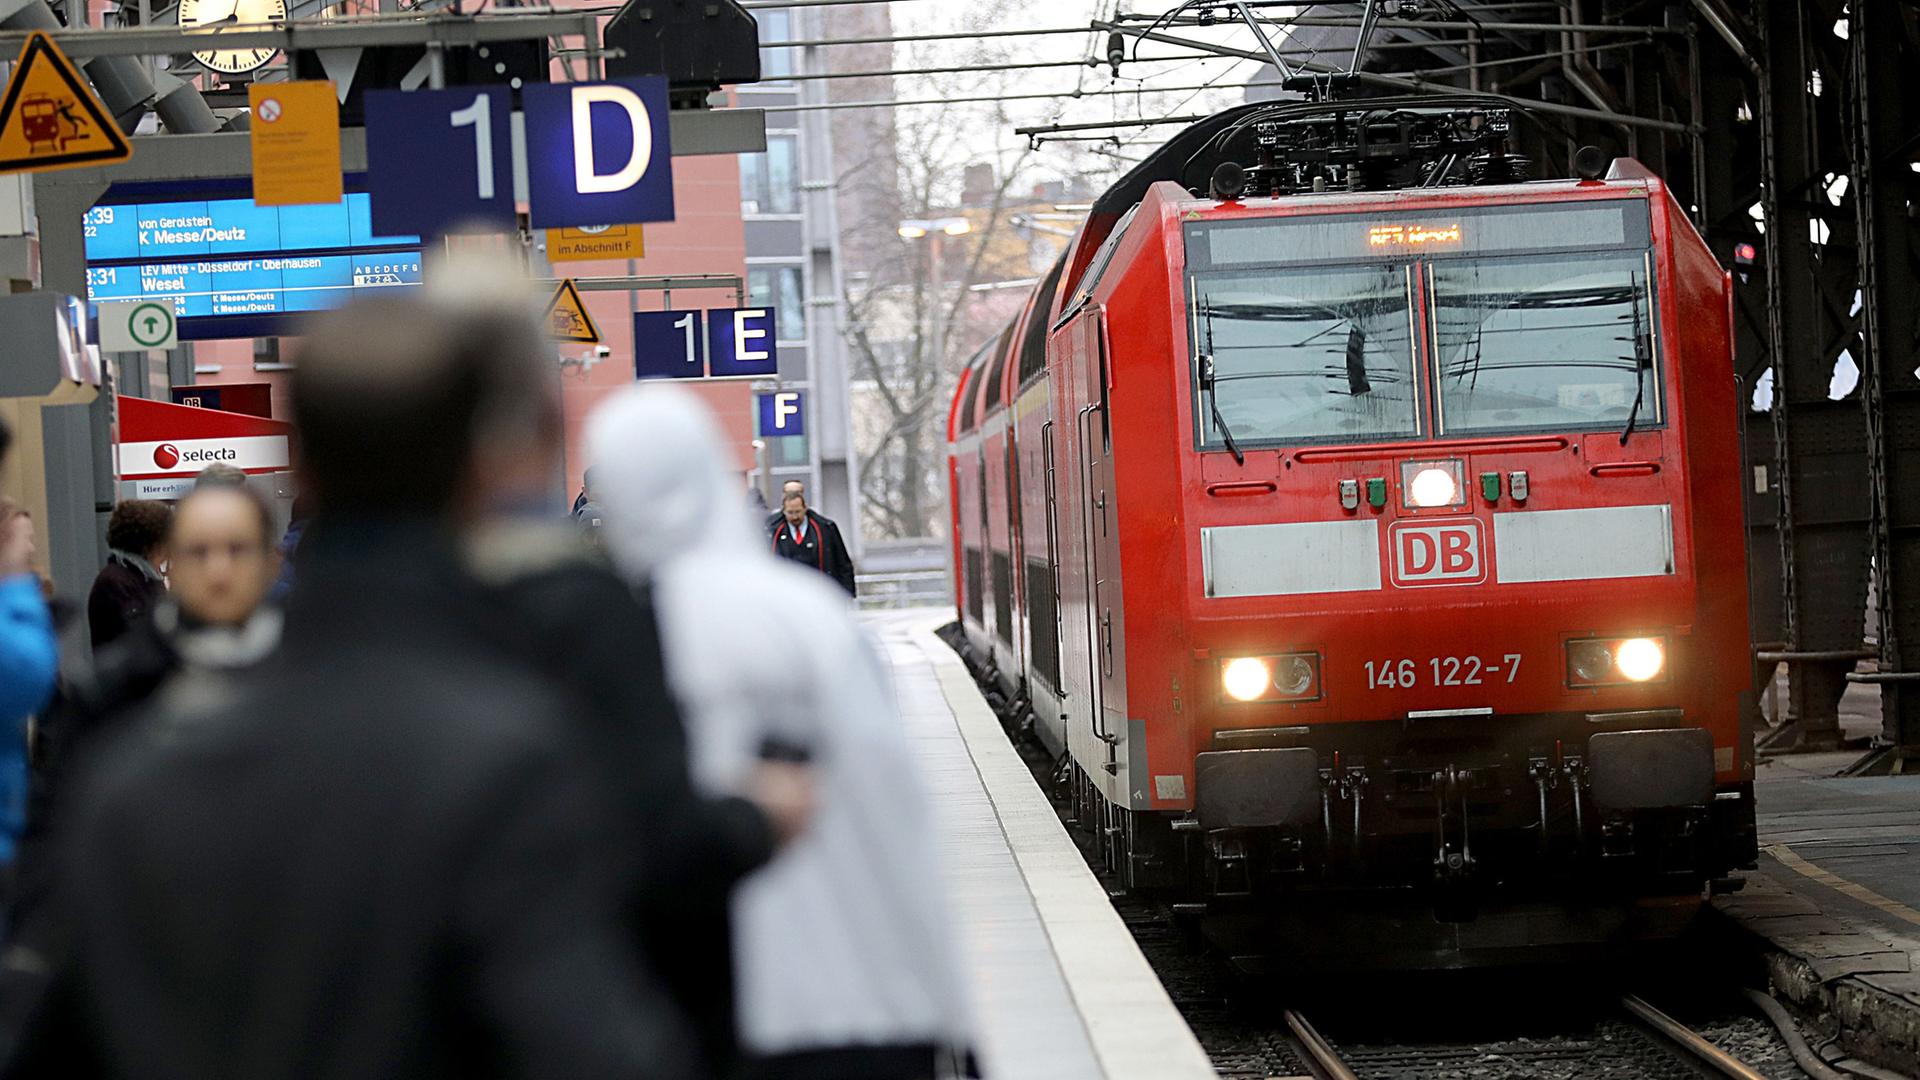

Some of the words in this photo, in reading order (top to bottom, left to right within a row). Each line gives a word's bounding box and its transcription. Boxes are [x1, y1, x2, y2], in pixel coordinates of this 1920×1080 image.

[450, 93, 494, 199] 1
[571, 85, 652, 194] D
[85, 226, 97, 237] 22
[139, 219, 158, 229] von
[160, 216, 212, 228] Gerolstein
[139, 231, 150, 245] K
[155, 227, 246, 243] Messe/Deutz
[558, 244, 571, 254] im
[574, 242, 622, 254] Abschnitt
[625, 240, 632, 251] F
[141, 265, 159, 276] LEV
[162, 264, 189, 275] Mitte
[198, 260, 253, 274] Düsseldorf
[262, 258, 321, 271] Oberhausen
[142, 277, 185, 291] Wesel
[674, 313, 695, 362] 1
[734, 310, 769, 361] E
[775, 393, 799, 429] F
[183, 447, 236, 462] selecta
[143, 485, 160, 493] Hier
[1402, 530, 1474, 575] DB
[1364, 659, 1416, 690] 146
[1430, 653, 1522, 687] 122-7
